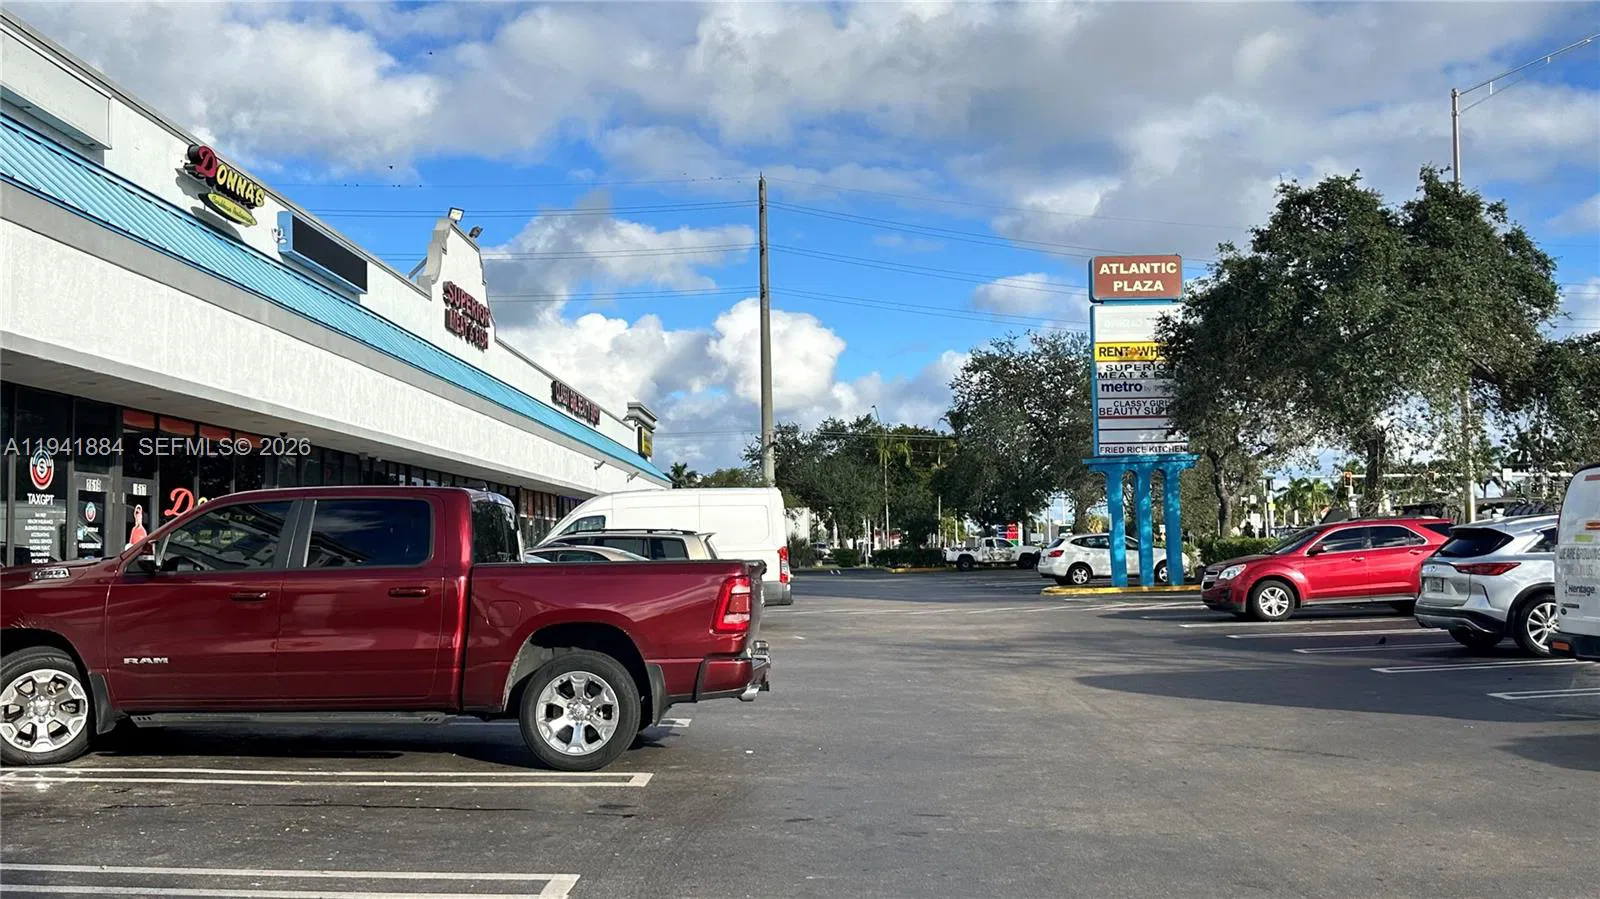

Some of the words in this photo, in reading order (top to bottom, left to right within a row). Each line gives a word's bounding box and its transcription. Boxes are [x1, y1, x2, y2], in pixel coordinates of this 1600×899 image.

[1099, 262, 1177, 275] ATLANTIC
[1113, 280, 1165, 292] PLAZA
[446, 281, 491, 325] SUPERIOR
[1098, 346, 1130, 357] RENT
[1105, 363, 1167, 372] SUPERIO
[1097, 371, 1135, 379] MEAT
[1101, 381, 1143, 392] metro
[1113, 400, 1147, 408] CLASSY
[1098, 407, 1140, 416] BEAUTY
[1100, 446, 1125, 454] FRIED
[1127, 446, 1146, 454] RICE
[1148, 445, 1188, 453] KITCHEN
[26, 493, 55, 506] TAXGPT
[123, 657, 169, 665] RAM
